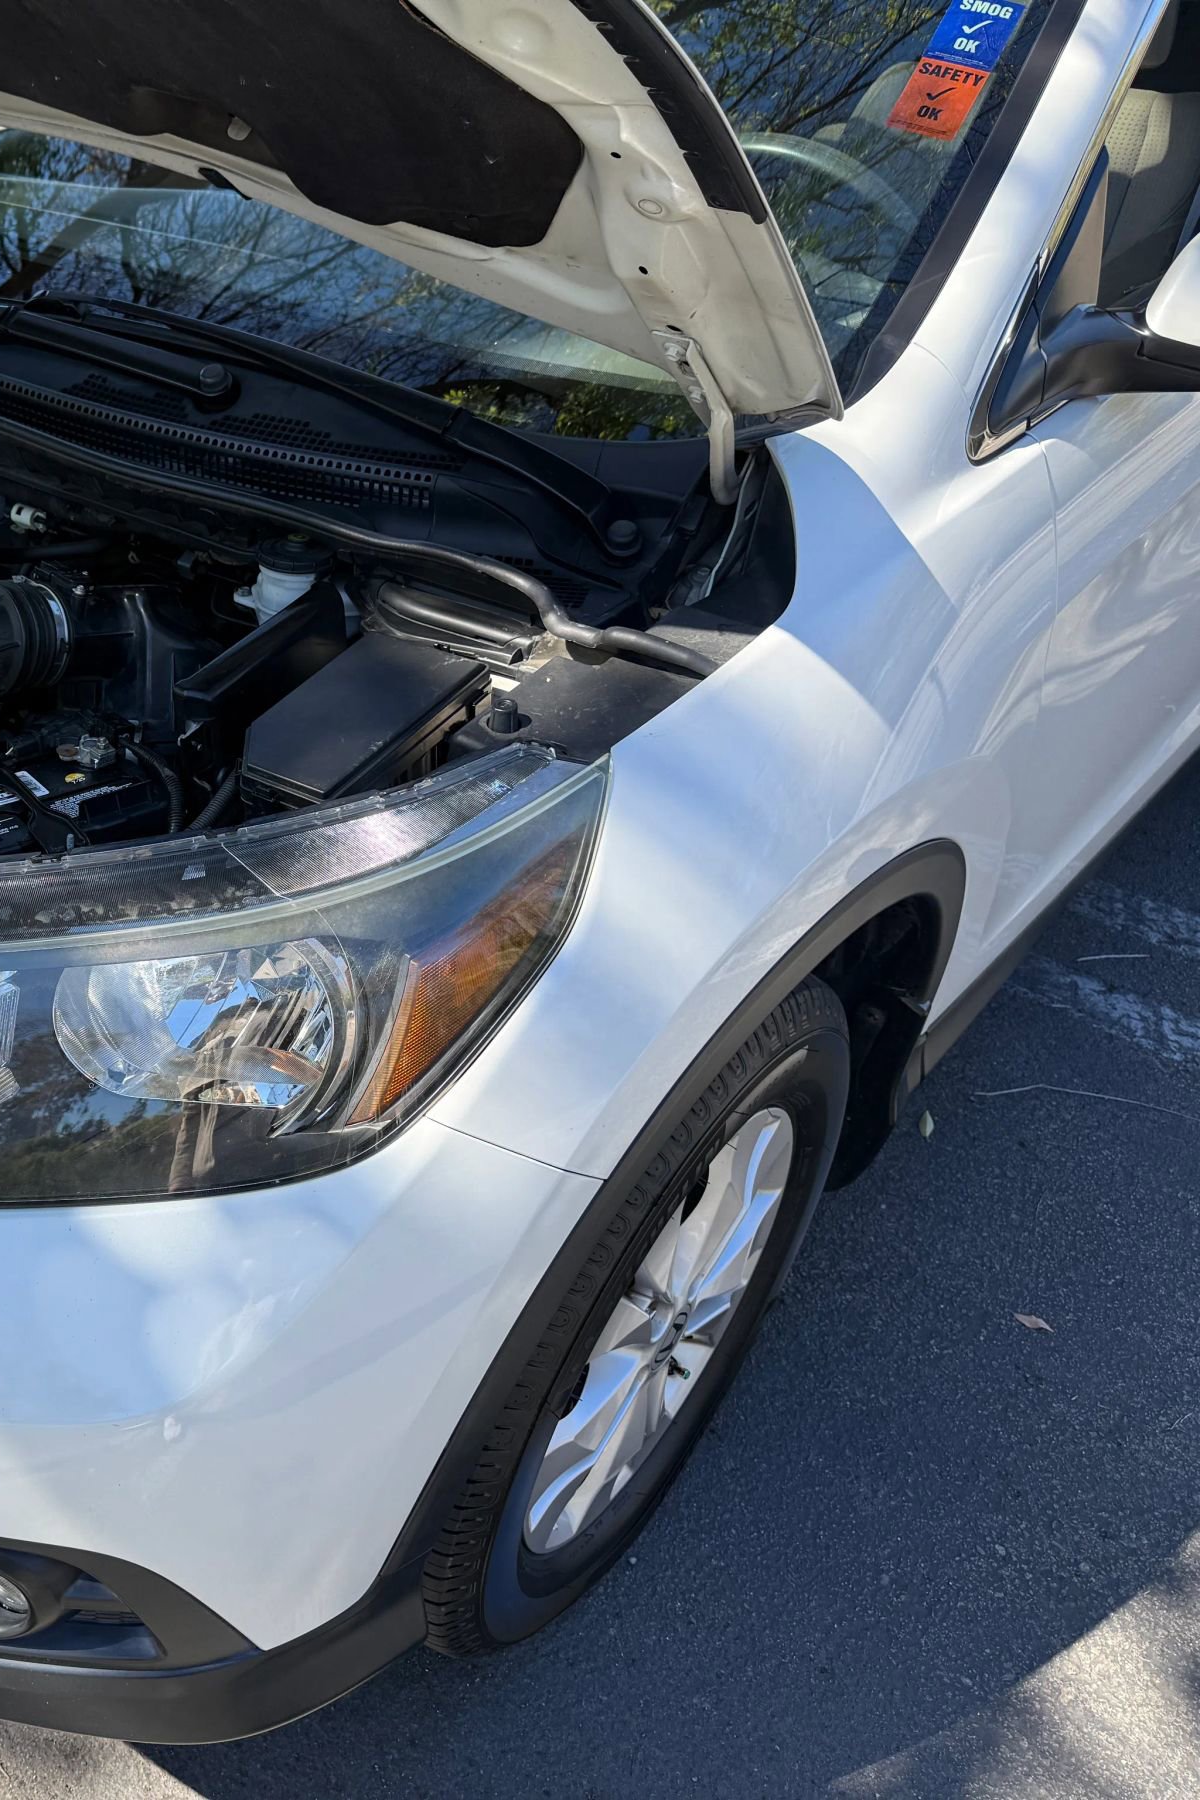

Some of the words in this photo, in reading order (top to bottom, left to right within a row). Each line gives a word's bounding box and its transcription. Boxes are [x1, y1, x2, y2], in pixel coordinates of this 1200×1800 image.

[960, 0, 1013, 19] SMOG
[953, 37, 981, 53] OK
[918, 62, 984, 87] SAFETY
[916, 105, 943, 120] OK
